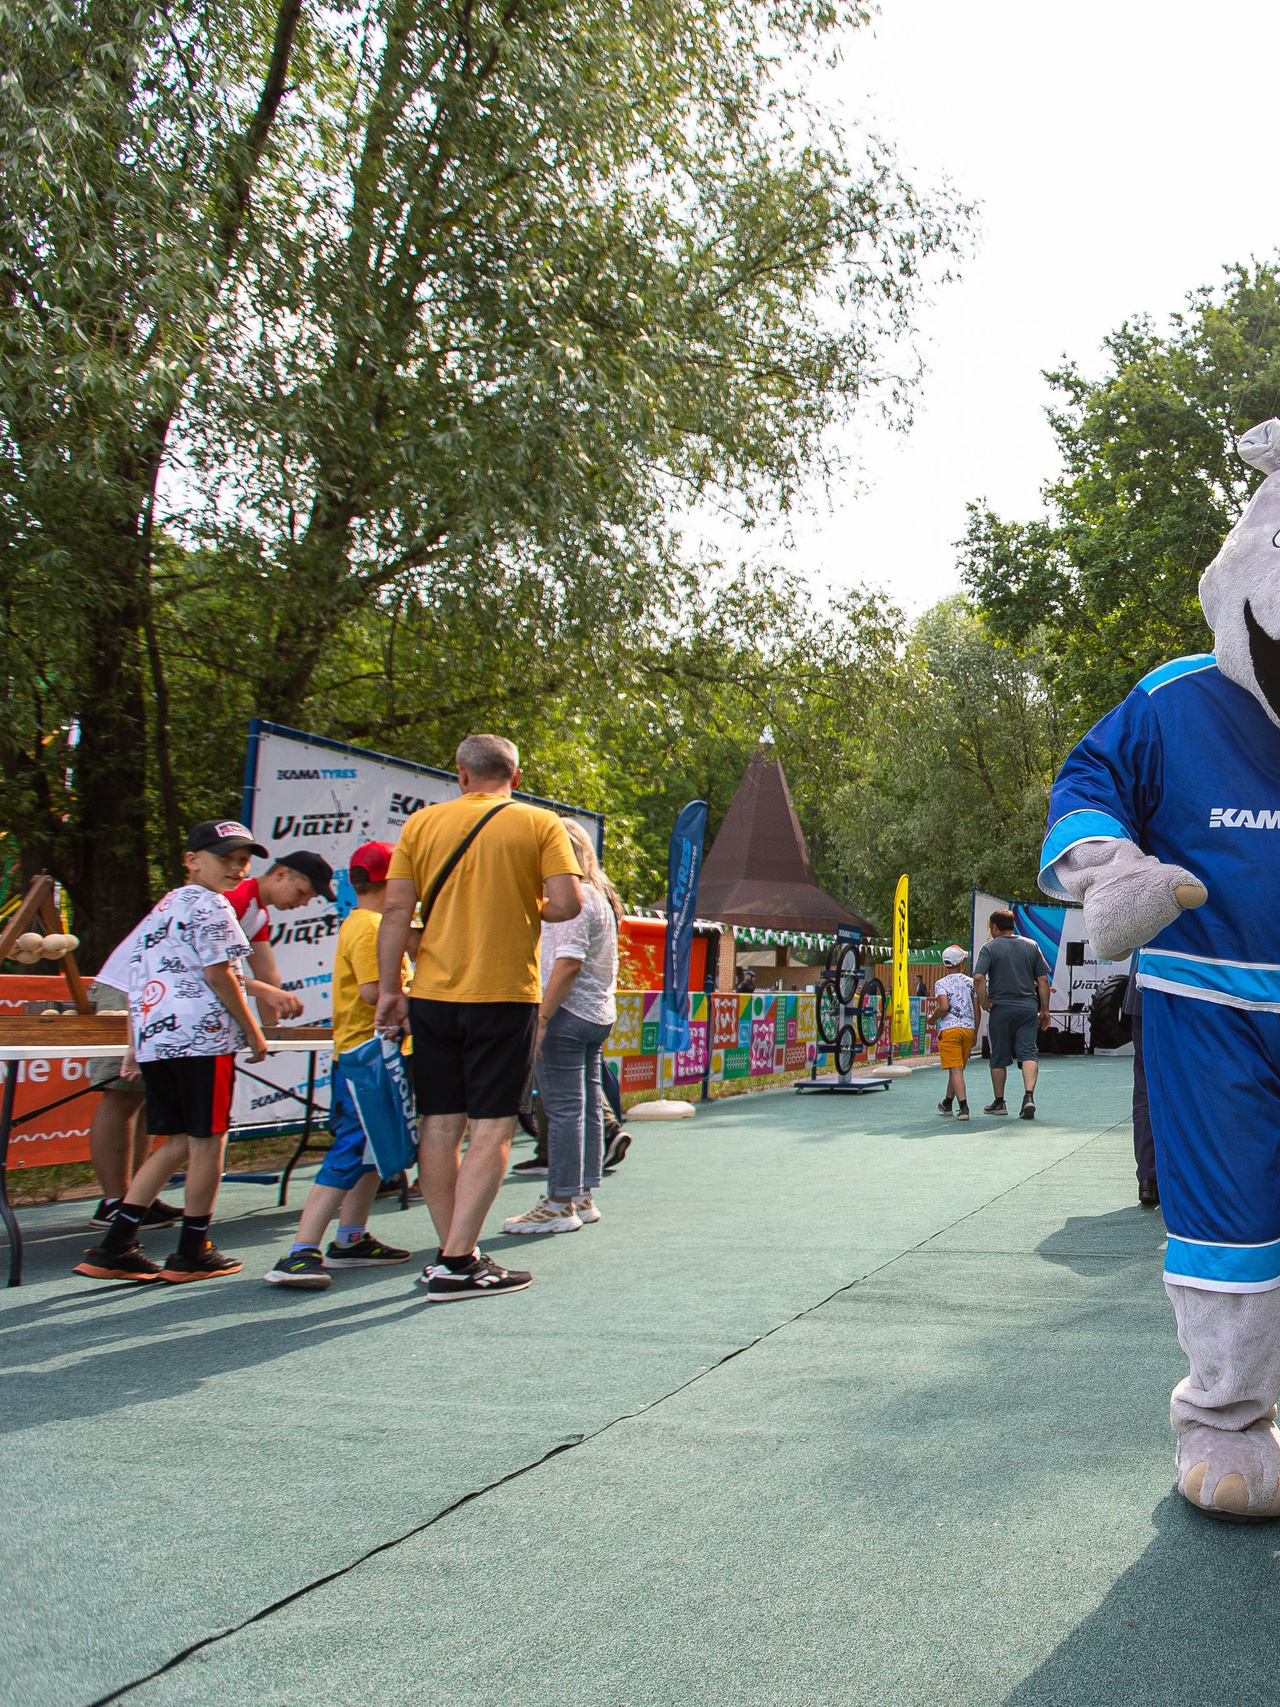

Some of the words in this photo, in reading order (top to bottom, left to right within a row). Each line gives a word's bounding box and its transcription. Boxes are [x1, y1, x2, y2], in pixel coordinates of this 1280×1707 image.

[277, 769, 320, 780] KAMA
[320, 768, 357, 779] TYRES
[272, 812, 354, 840] Viatti
